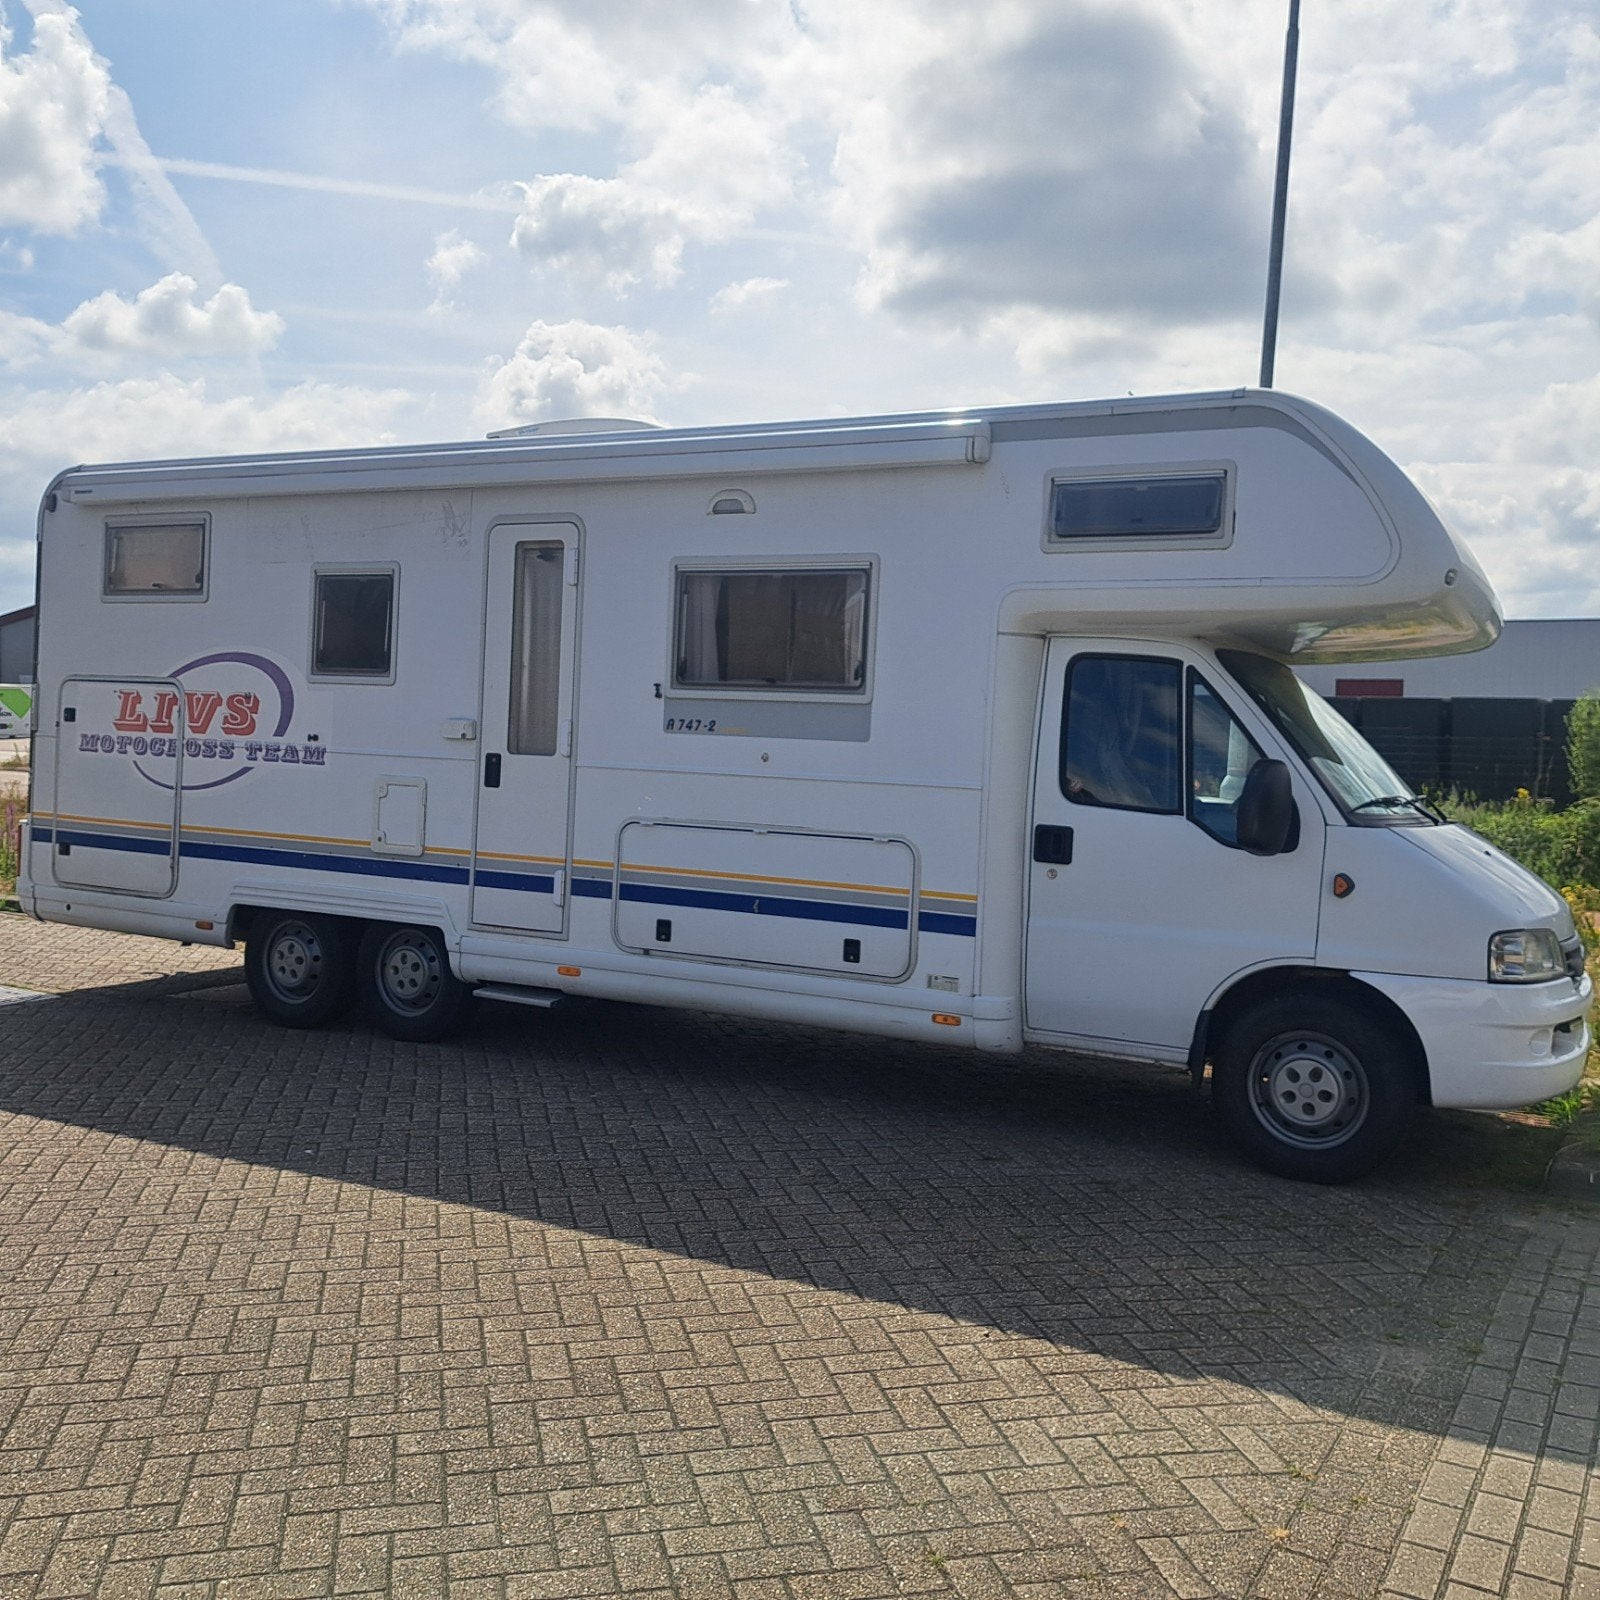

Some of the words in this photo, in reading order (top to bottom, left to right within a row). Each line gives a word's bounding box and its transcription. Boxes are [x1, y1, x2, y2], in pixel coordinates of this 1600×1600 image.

[112, 689, 260, 736] LIVS
[666, 718, 676, 731] A
[678, 718, 717, 732] 747-2
[244, 741, 327, 766] TEAM
